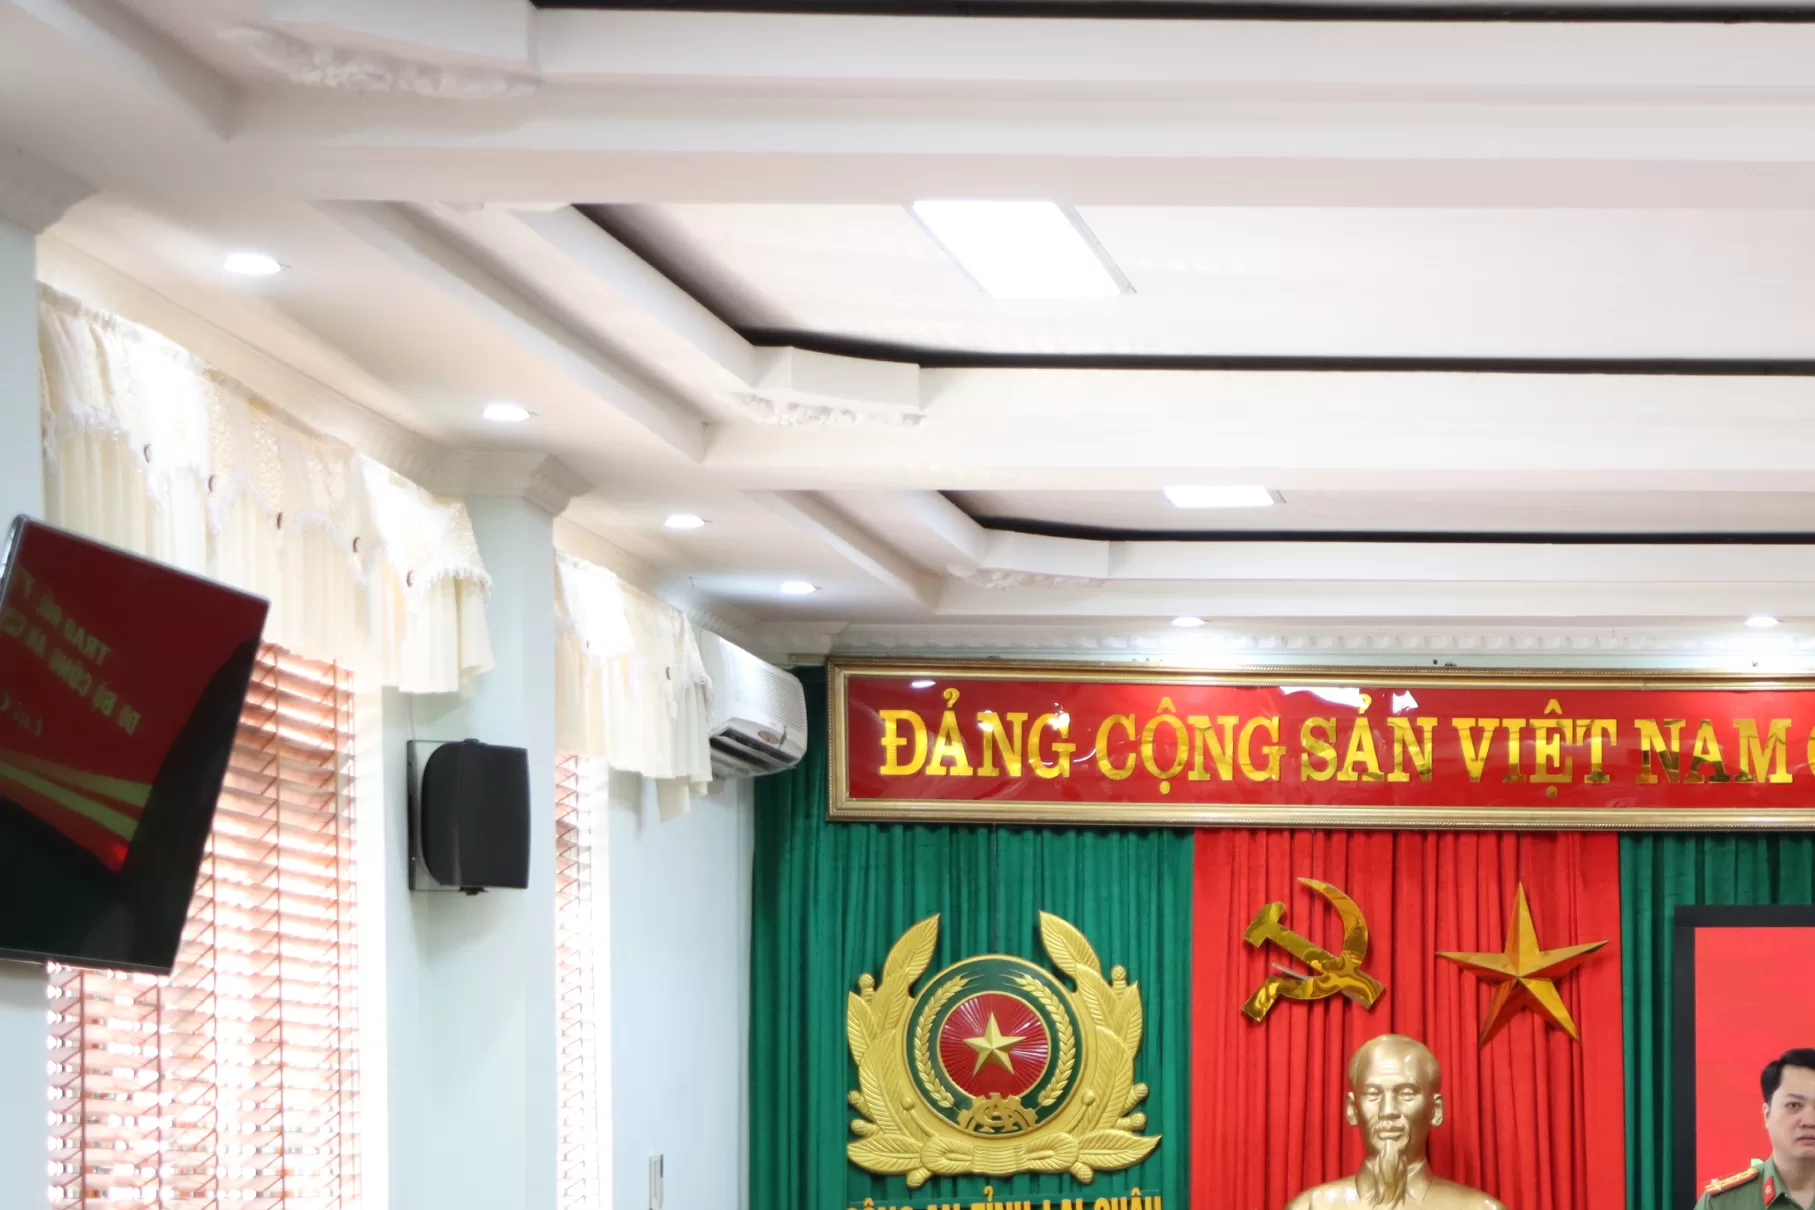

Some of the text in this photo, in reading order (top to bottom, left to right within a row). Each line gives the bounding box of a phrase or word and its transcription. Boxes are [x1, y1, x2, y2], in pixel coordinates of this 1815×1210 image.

[879, 688, 1076, 778] ĐẢNG
[1095, 696, 1287, 795] CỘNG
[1300, 693, 1439, 783] SẢN
[1452, 698, 1618, 798] VIỆT
[1634, 718, 1794, 784] NAM
